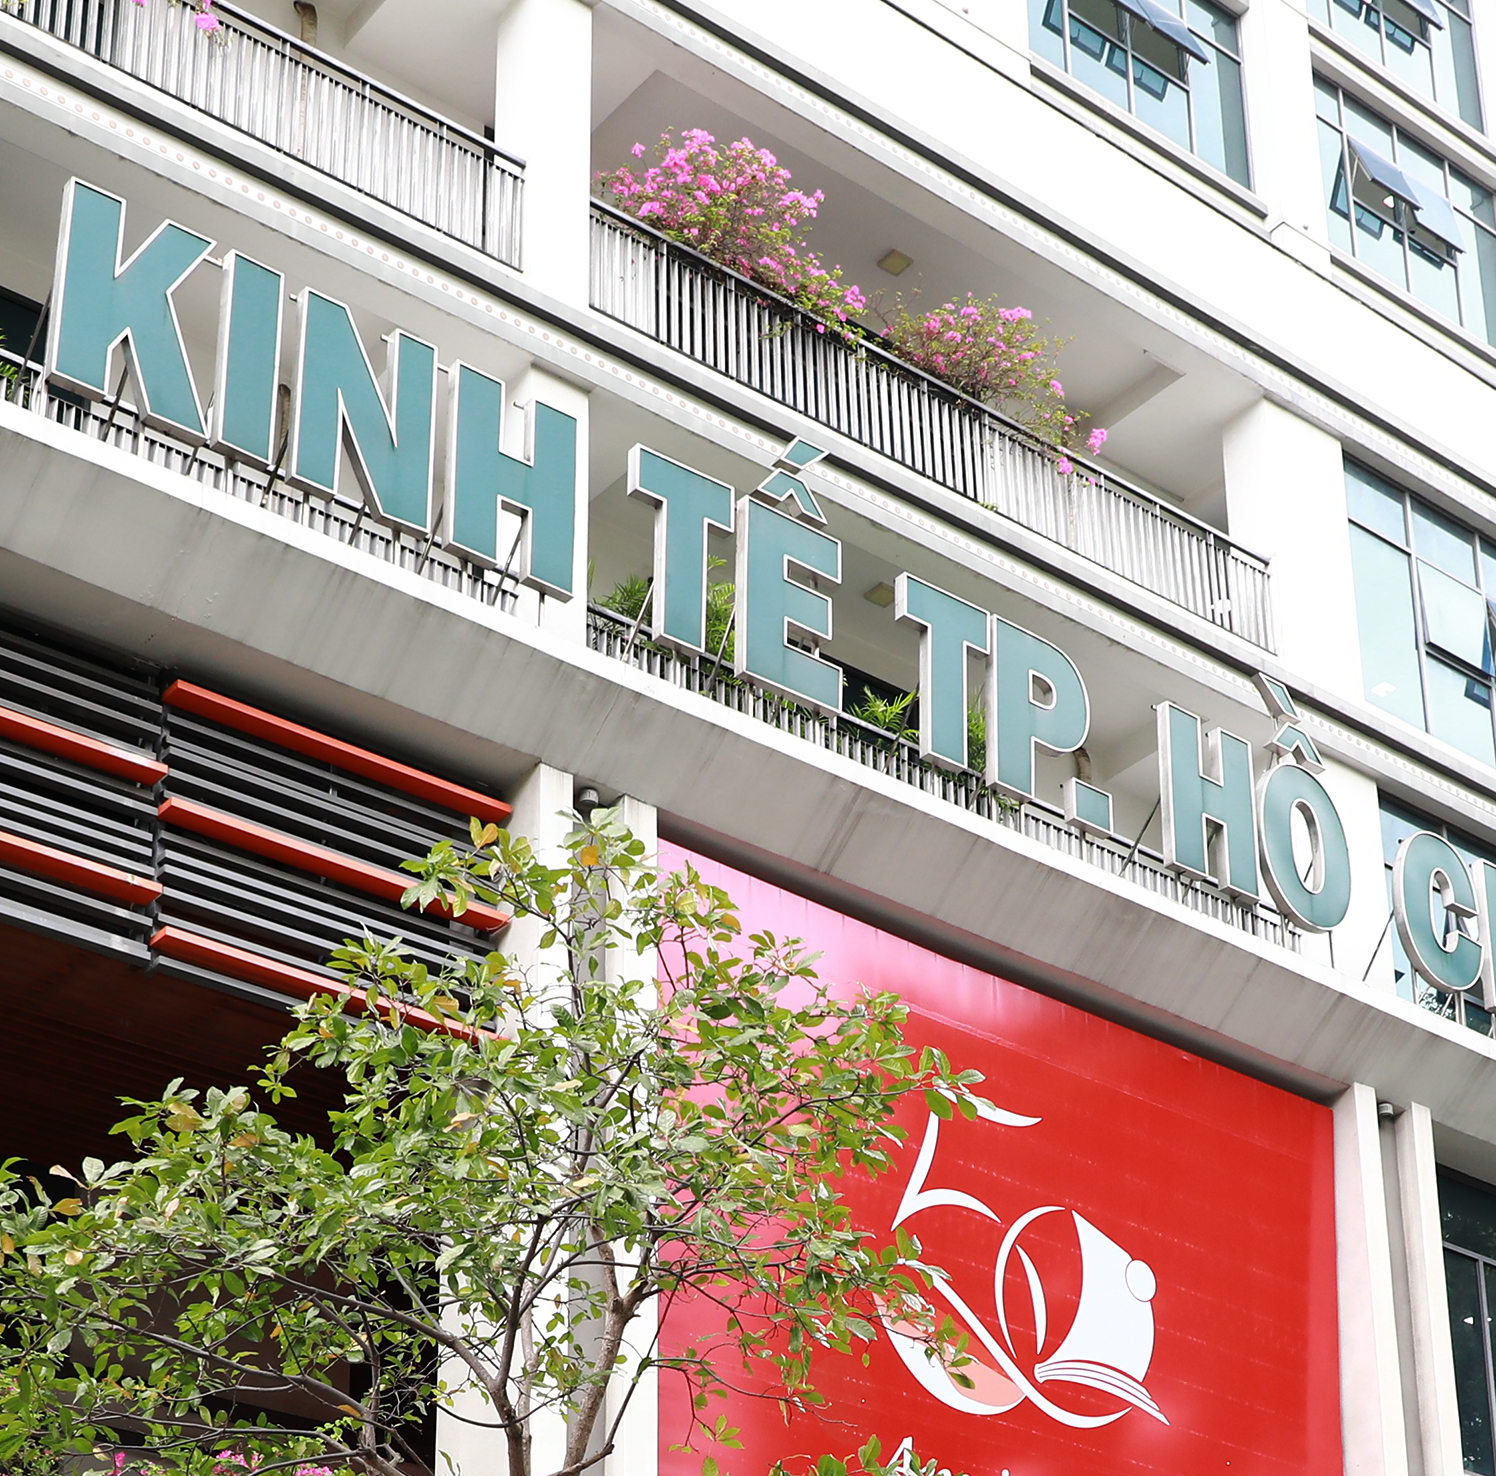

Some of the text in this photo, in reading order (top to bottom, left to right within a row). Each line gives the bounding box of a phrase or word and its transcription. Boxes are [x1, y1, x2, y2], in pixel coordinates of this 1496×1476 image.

[45, 176, 588, 601] KINH
[627, 436, 844, 717] TẾ
[895, 571, 1114, 840] TP.
[1157, 672, 1351, 932] HỒ
